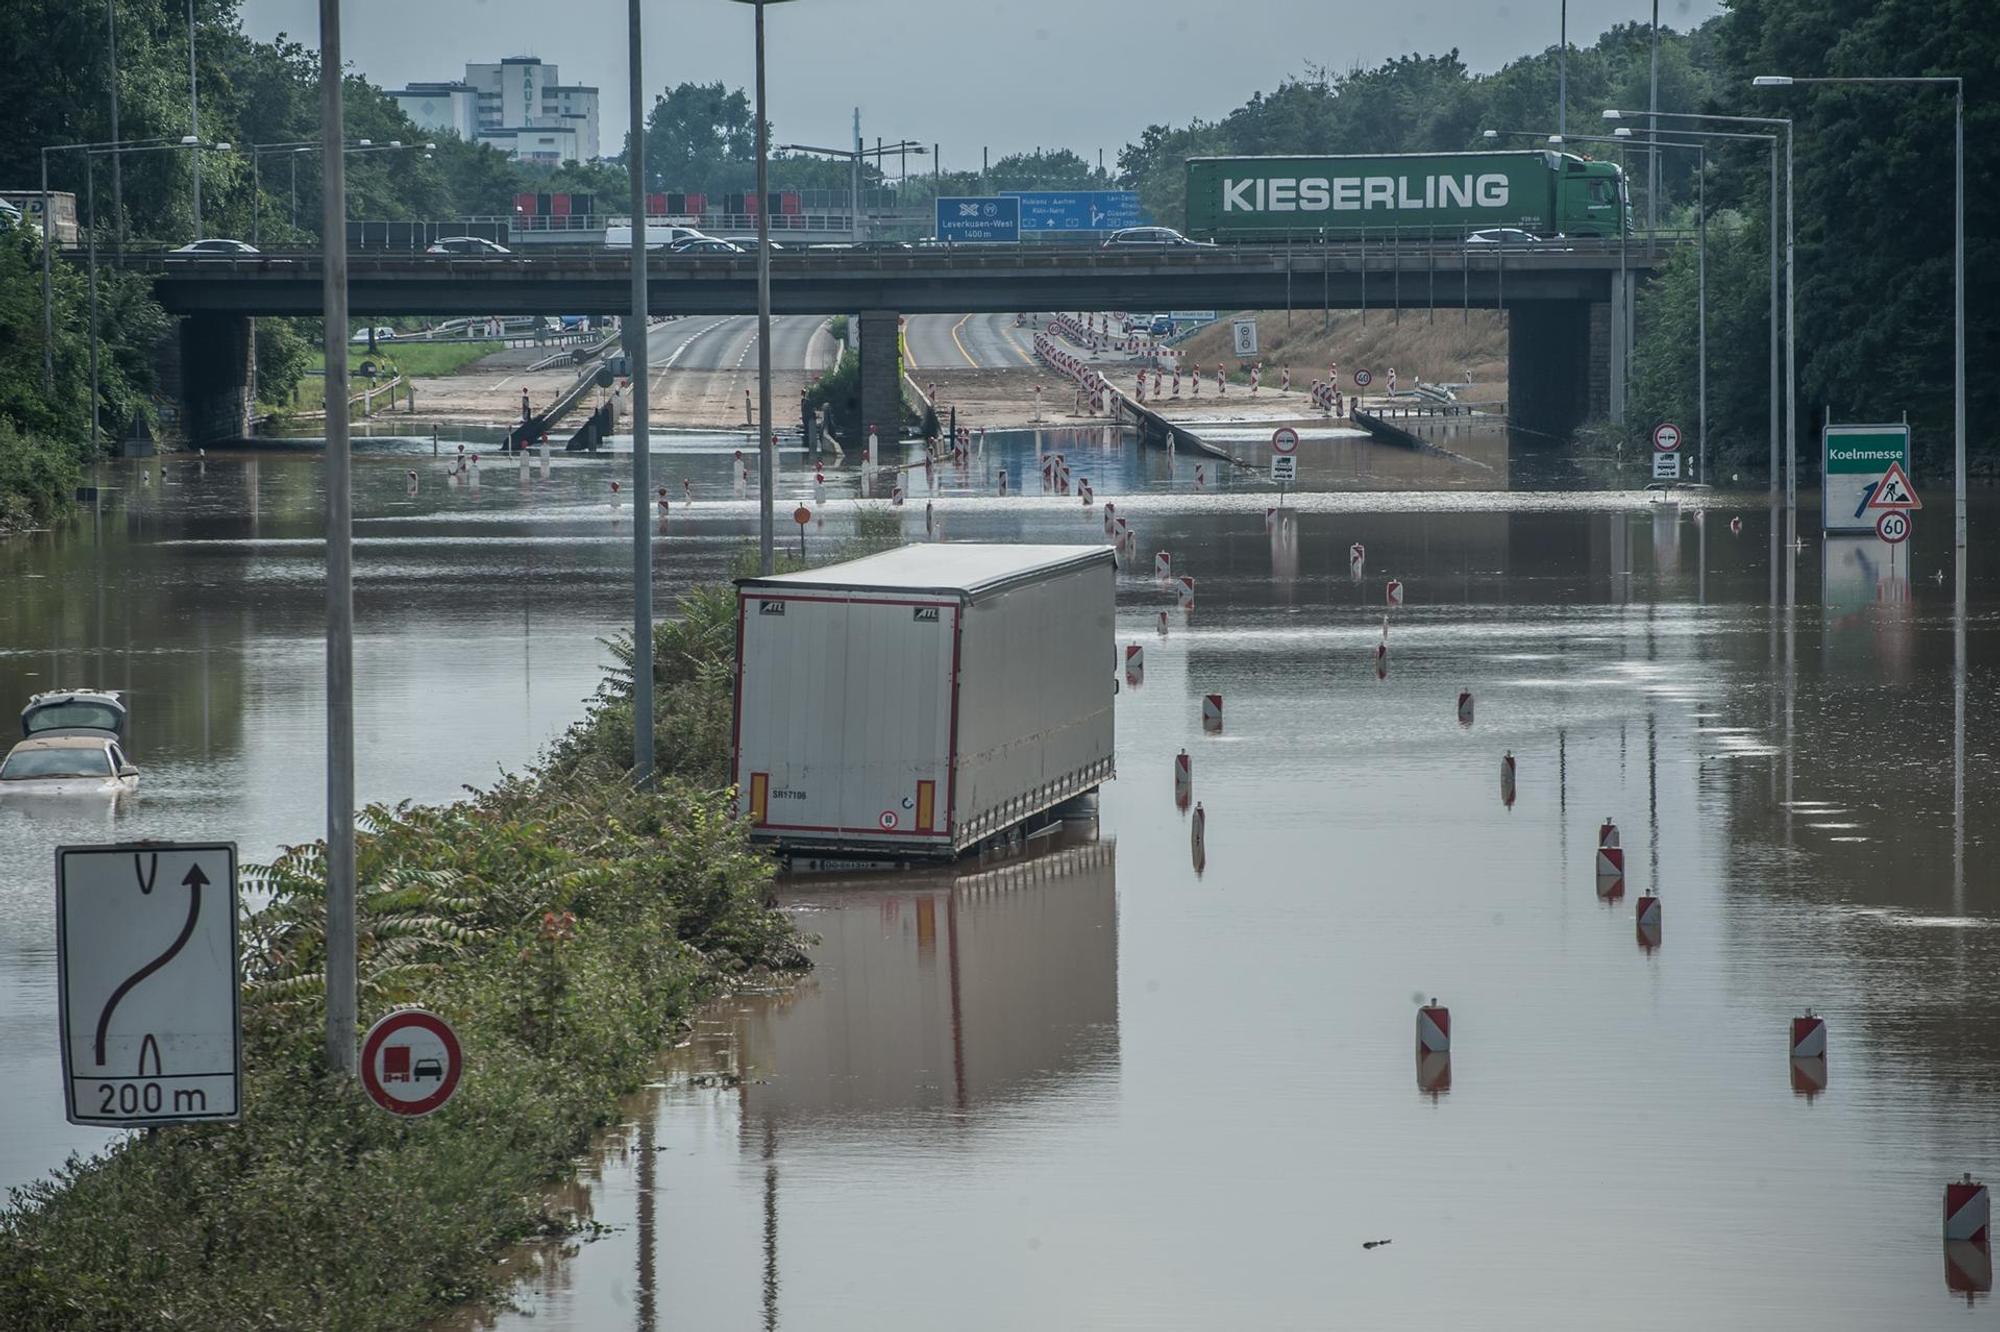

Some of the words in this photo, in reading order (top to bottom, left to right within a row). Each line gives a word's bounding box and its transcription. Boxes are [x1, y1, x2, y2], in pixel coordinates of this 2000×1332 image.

[1224, 173, 1509, 211] KIESERLING
[942, 219, 1013, 228] Leverkusen-West
[964, 230, 982, 238] 1400
[1830, 448, 1903, 460] Koelnmesse
[1884, 519, 1904, 535] 60
[98, 1082, 162, 1114] 200
[174, 1088, 206, 1112] m
